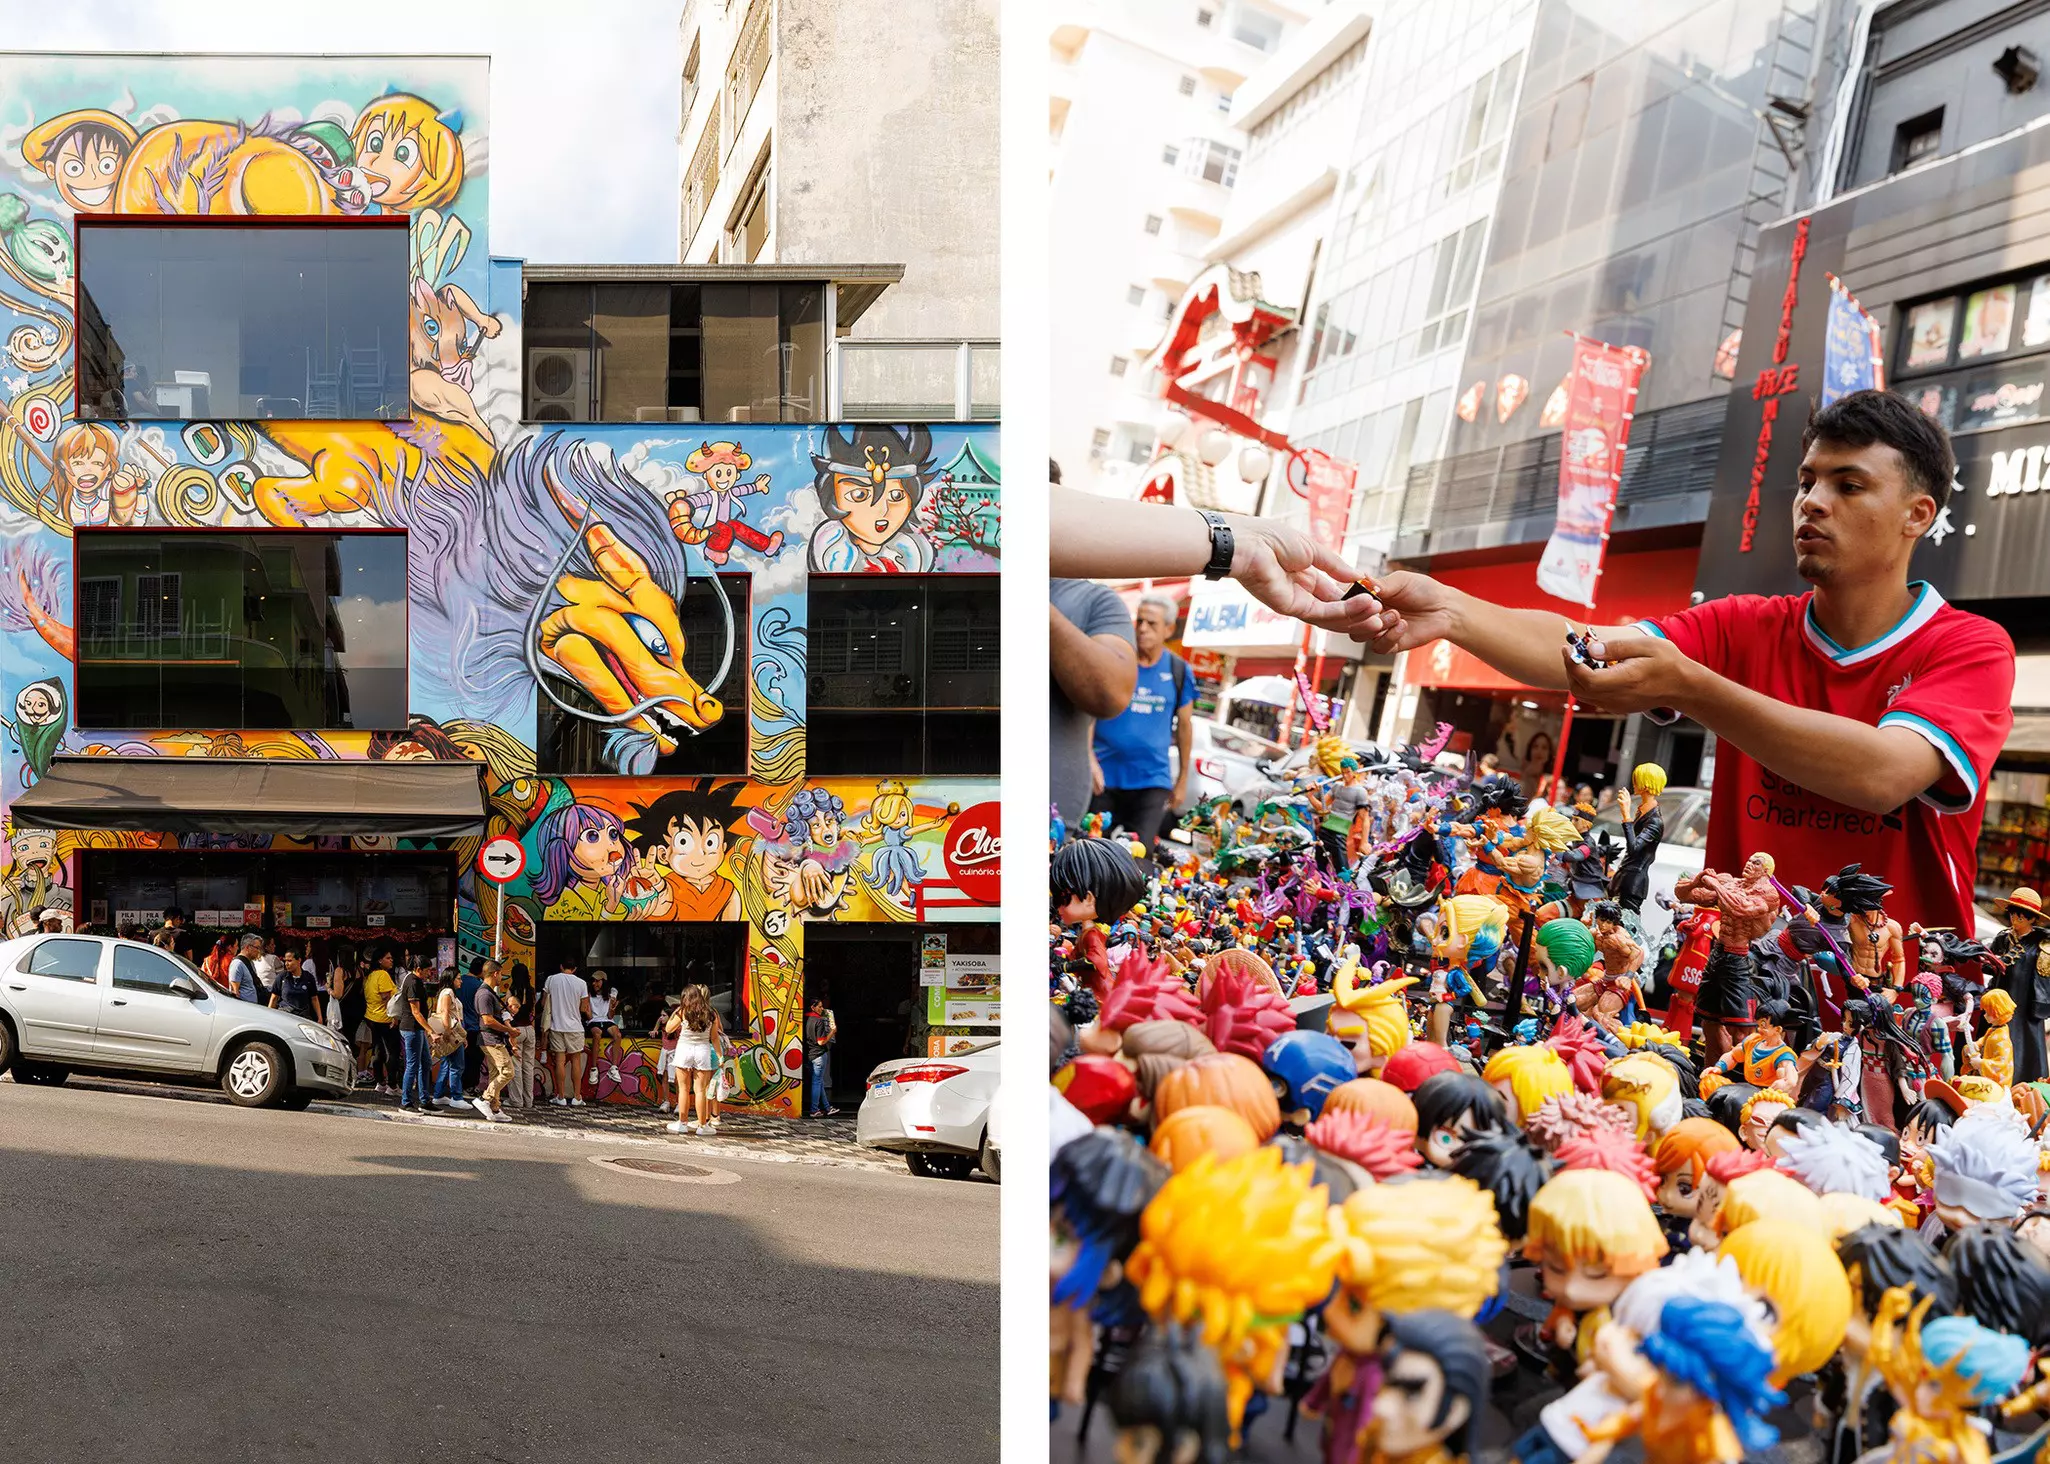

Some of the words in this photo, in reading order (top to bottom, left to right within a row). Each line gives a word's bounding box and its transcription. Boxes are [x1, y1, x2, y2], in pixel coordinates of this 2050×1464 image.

[1772, 217, 1812, 364] SHIATSU
[1739, 398, 1780, 552] MASSAGE
[1746, 794, 1876, 835] Chartered
[766, 912, 787, 933] 57
[1681, 966, 1703, 986] SSG
